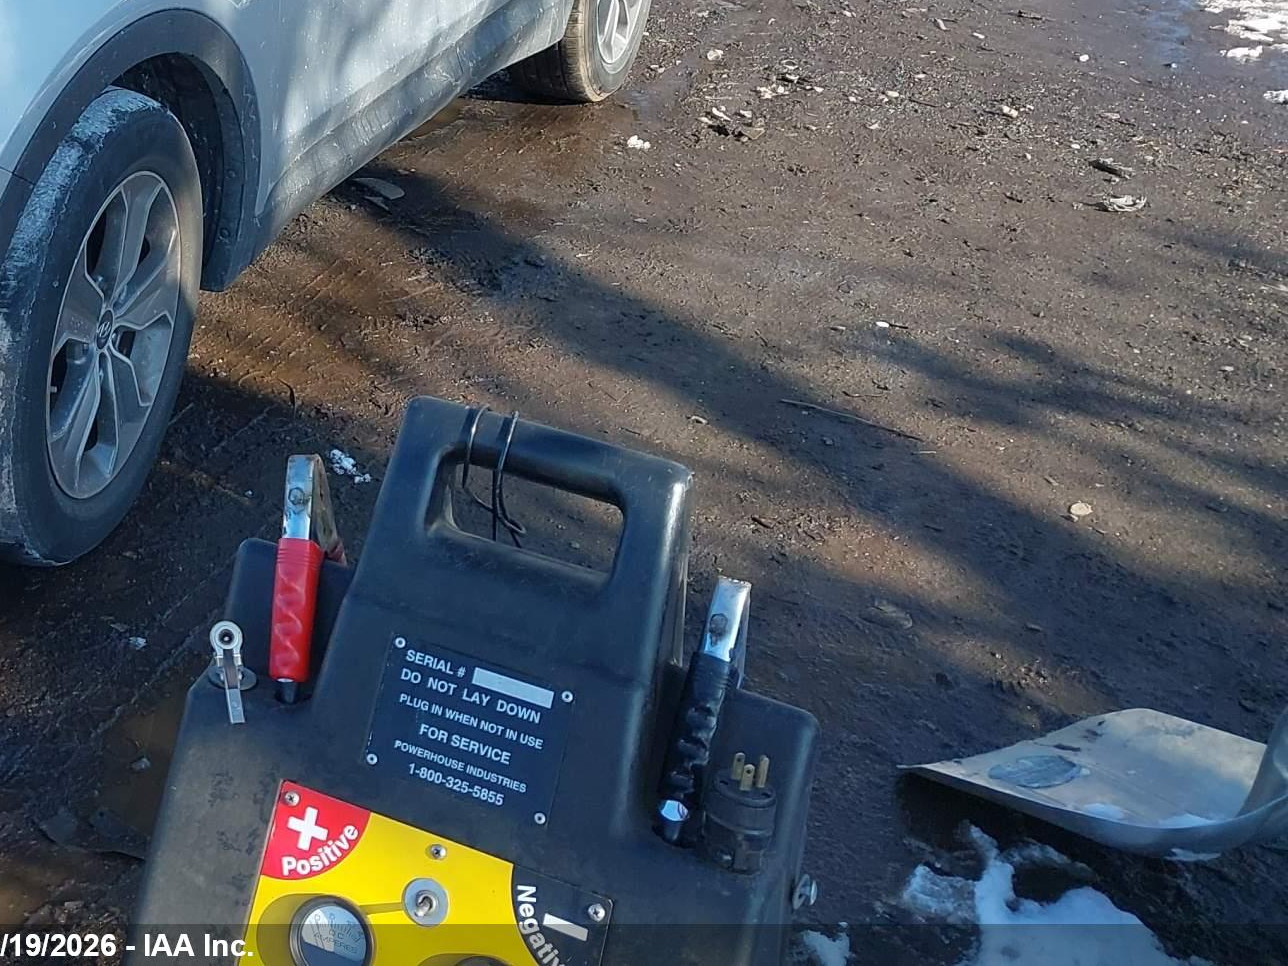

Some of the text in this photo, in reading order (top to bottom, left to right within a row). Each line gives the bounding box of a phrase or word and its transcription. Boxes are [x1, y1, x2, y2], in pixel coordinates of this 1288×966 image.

[406, 649, 466, 678] SERIAL #
[400, 667, 540, 724] DO NOT LAY DOWN
[399, 693, 543, 750] PLUG IN WHEN NOT IN USE
[419, 723, 511, 765] FOR SERVICE
[394, 739, 527, 793] POWERHOUSE INDUSTRIES
[408, 762, 505, 806] 1-800-325-5855
[281, 825, 359, 876] Positive
